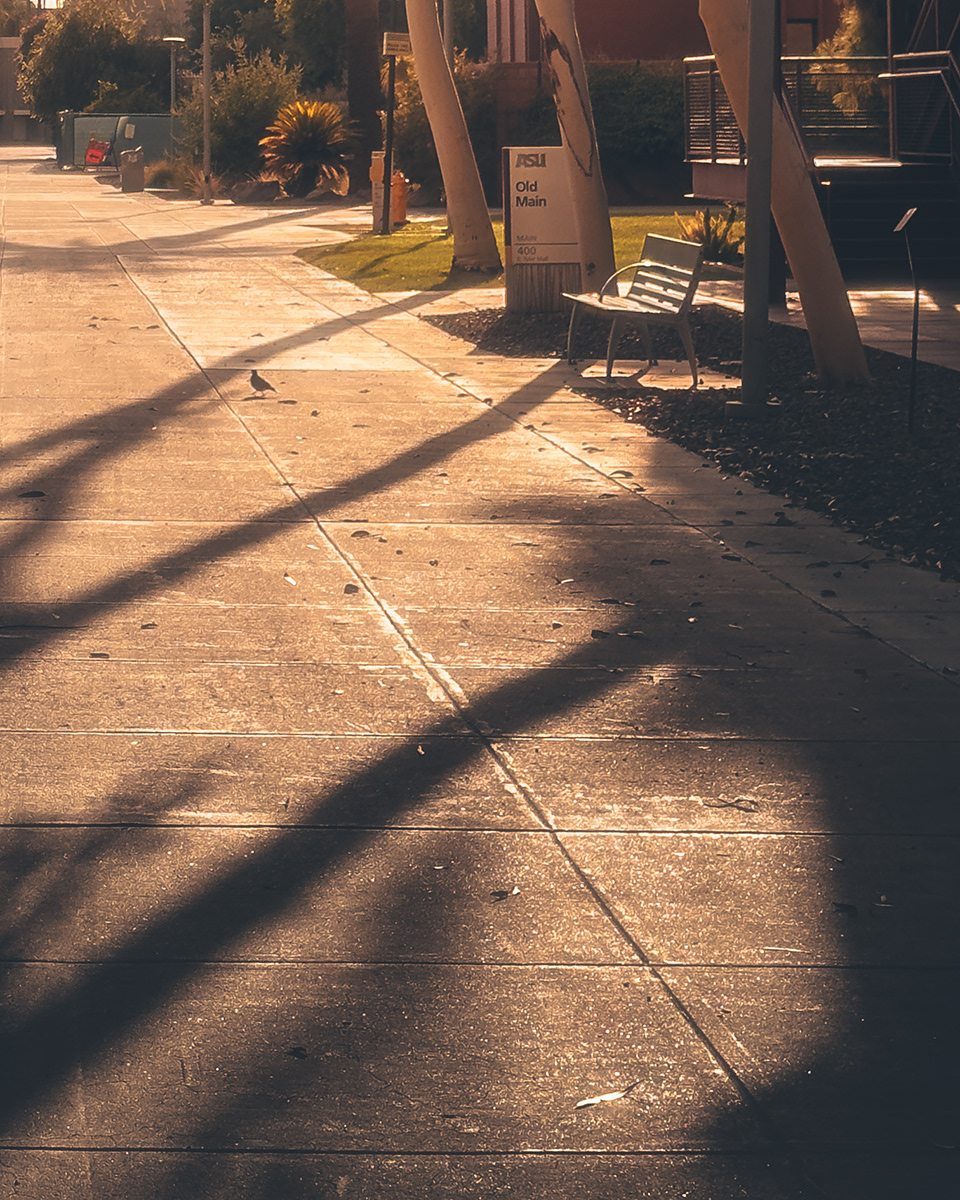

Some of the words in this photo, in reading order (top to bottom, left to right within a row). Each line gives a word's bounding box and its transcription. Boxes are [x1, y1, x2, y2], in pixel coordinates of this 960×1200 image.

[515, 153, 546, 168] ASU
[516, 180, 537, 192] Old
[516, 195, 547, 207] Main
[517, 246, 536, 255] 400
